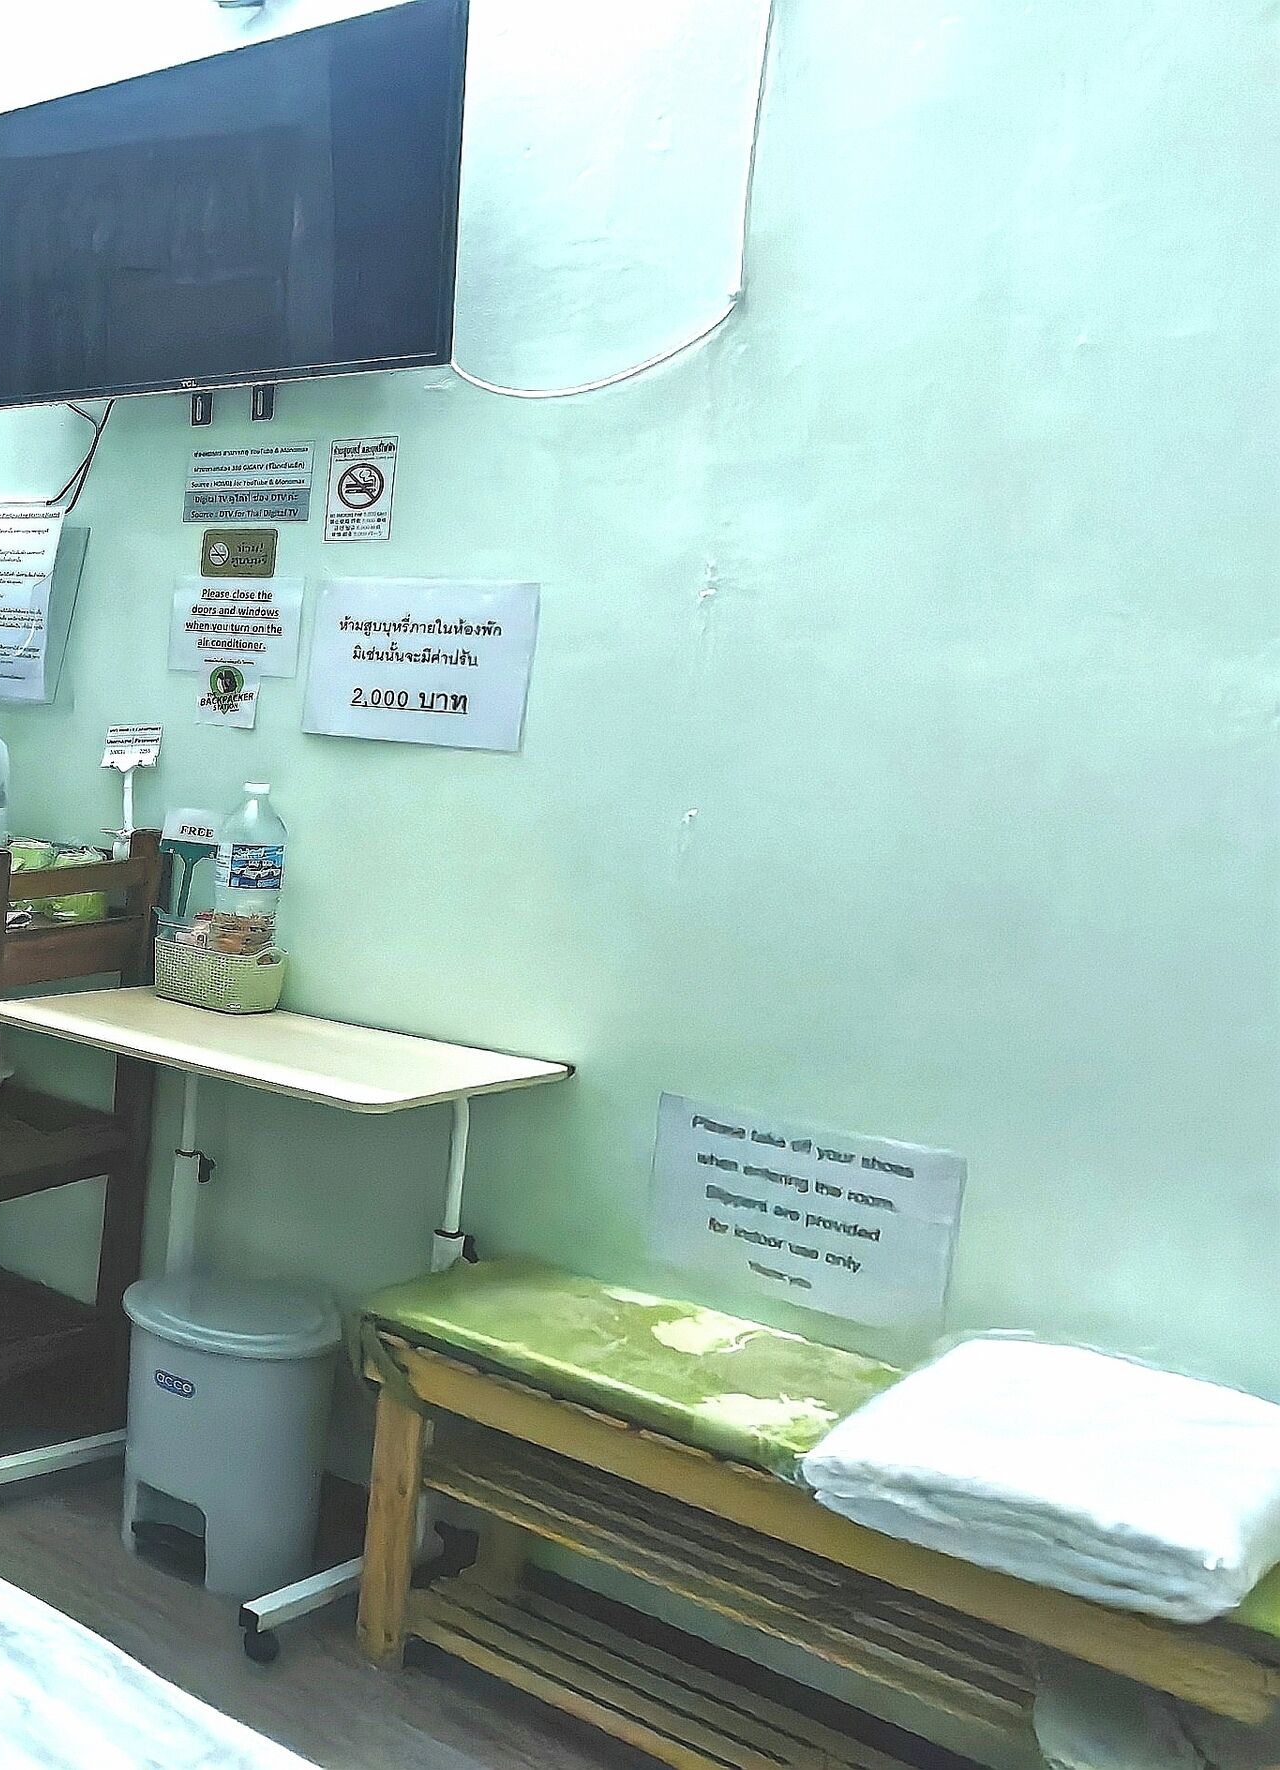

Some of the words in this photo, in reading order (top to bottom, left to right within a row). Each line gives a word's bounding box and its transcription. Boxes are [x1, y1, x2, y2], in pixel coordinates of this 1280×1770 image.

[180, 380, 196, 388] TCL
[271, 493, 287, 501] DTV
[191, 510, 214, 519] Source
[219, 510, 233, 518] DTV
[234, 510, 245, 518] for
[288, 508, 299, 517] TV
[201, 588, 230, 598] Please
[232, 589, 255, 599] close
[258, 590, 273, 600] the
[191, 604, 217, 614] doors
[219, 605, 236, 615] and
[238, 606, 280, 617] windows
[185, 621, 210, 631] when
[211, 623, 228, 633] you
[230, 622, 250, 633] turn
[252, 625, 265, 634] on
[267, 624, 283, 634] the
[197, 637, 209, 646] air
[211, 638, 267, 650] conditioner.
[200, 692, 255, 707] BACKPACKER
[351, 687, 409, 708] 2,000
[418, 691, 469, 713] บาท
[180, 825, 214, 838] FREE
[816, 1146, 856, 1163] your
[805, 1213, 881, 1242] provided
[156, 1372, 192, 1393] acco
